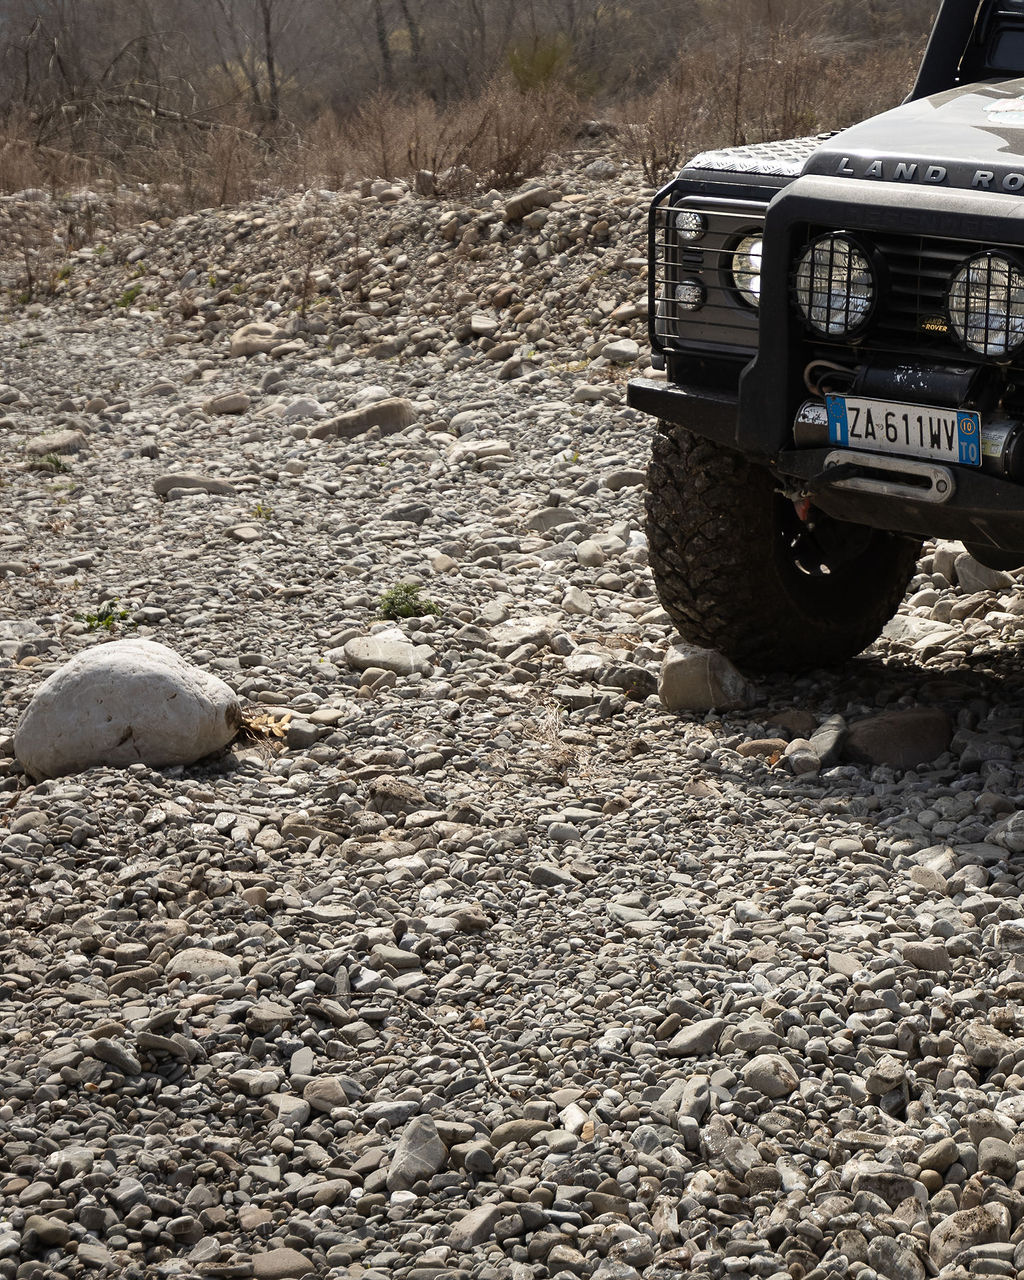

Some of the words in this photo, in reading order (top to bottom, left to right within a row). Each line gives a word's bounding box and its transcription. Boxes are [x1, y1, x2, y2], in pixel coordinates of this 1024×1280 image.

[834, 157, 948, 184] LAND
[925, 323, 948, 332] ROVER
[847, 407, 877, 441] ZA
[884, 411, 956, 451] 611WV
[960, 441, 978, 462] TO
